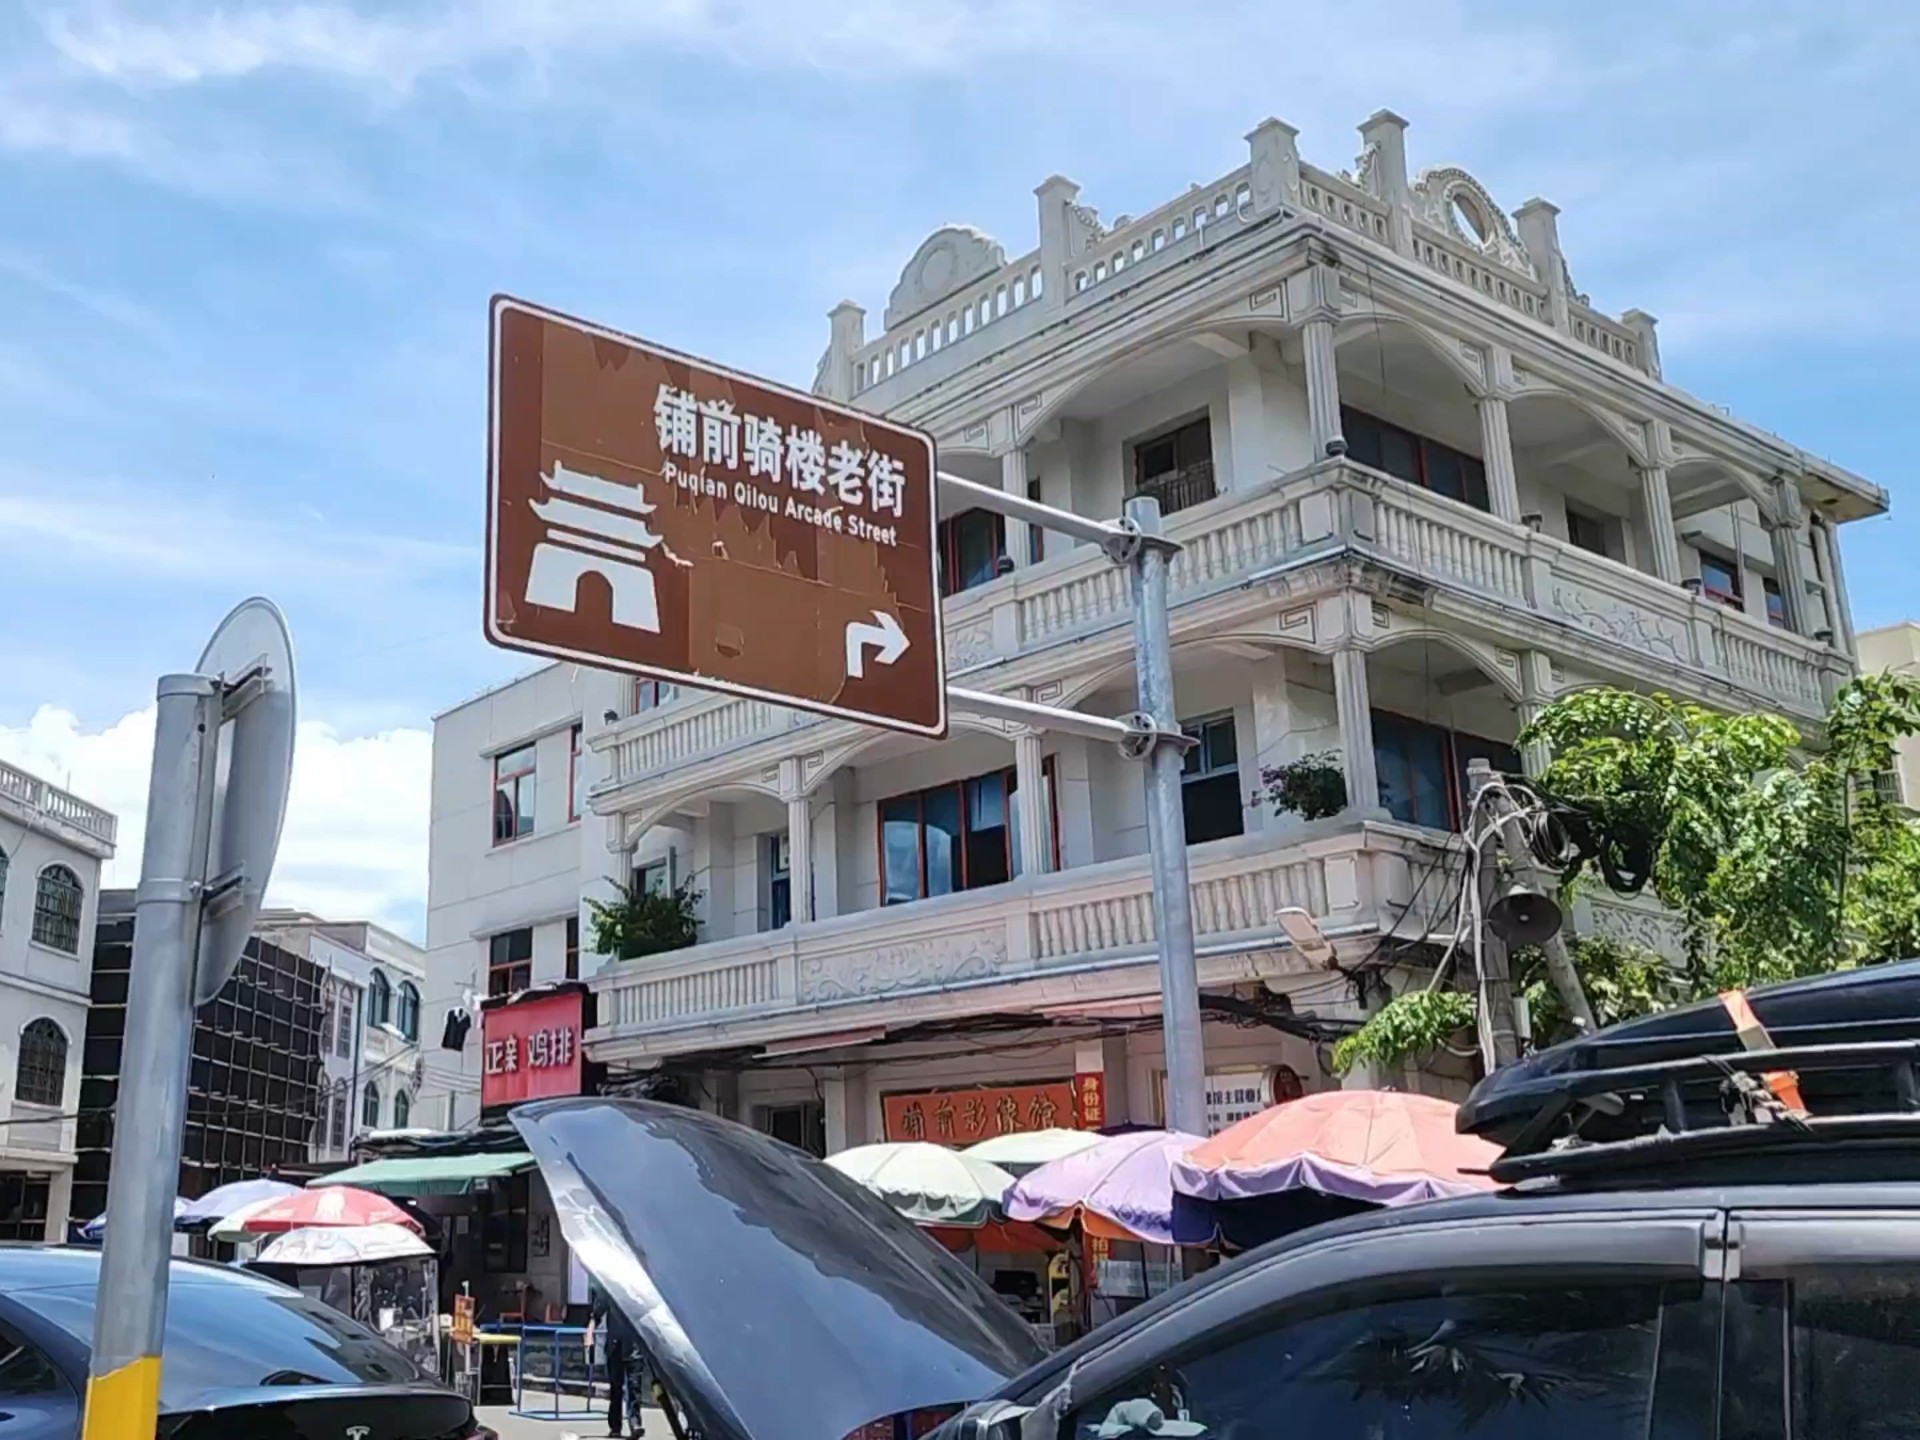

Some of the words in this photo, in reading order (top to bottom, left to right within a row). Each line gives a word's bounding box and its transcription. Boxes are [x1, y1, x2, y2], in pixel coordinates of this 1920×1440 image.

[653, 383, 906, 518] 铺前骑楼老街
[664, 461, 728, 499] Puqian
[734, 481, 779, 514] Qilou
[784, 497, 842, 531] Arcade
[848, 514, 897, 547] Street
